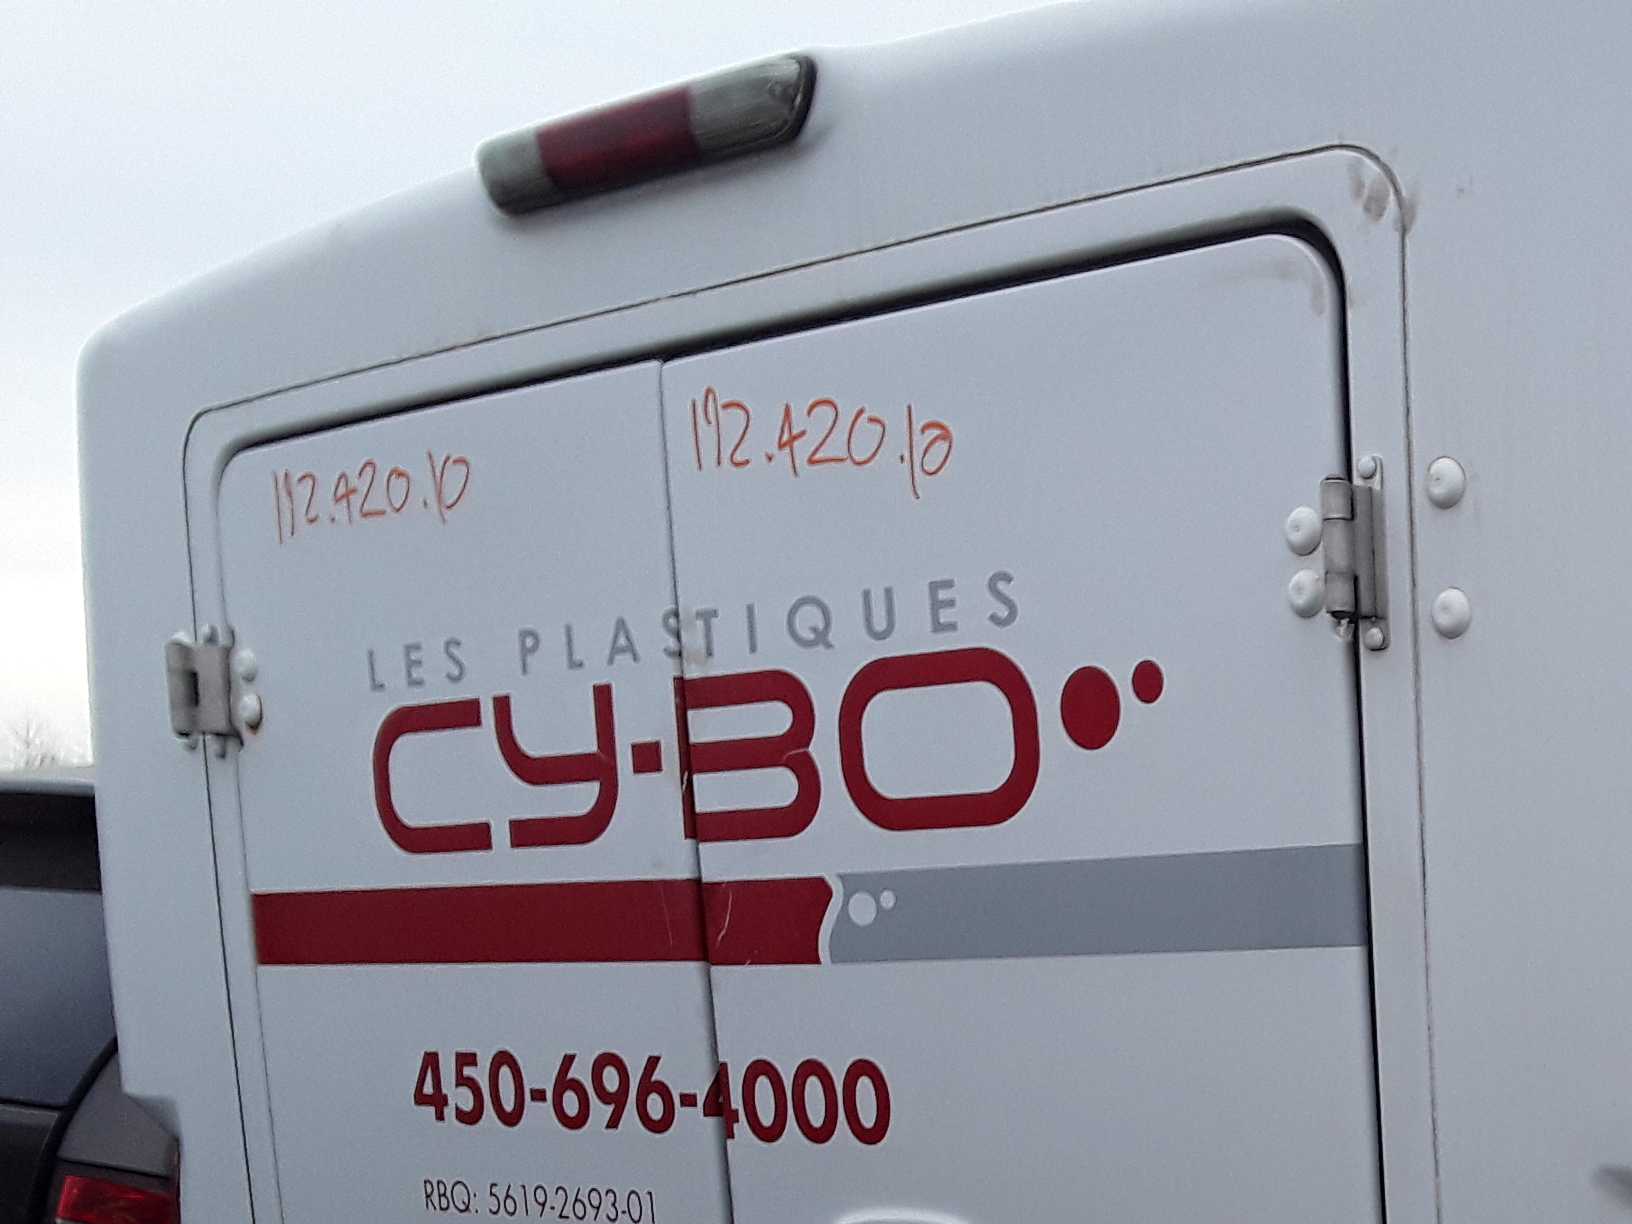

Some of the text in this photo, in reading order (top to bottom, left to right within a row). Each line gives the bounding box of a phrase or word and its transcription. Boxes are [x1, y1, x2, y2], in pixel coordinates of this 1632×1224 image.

[365, 570, 1020, 693] LES PLASTIQUES
[412, 1049, 892, 1146] 450-696-4000
[423, 1178, 657, 1224] RBQ: 5619-2693-01
